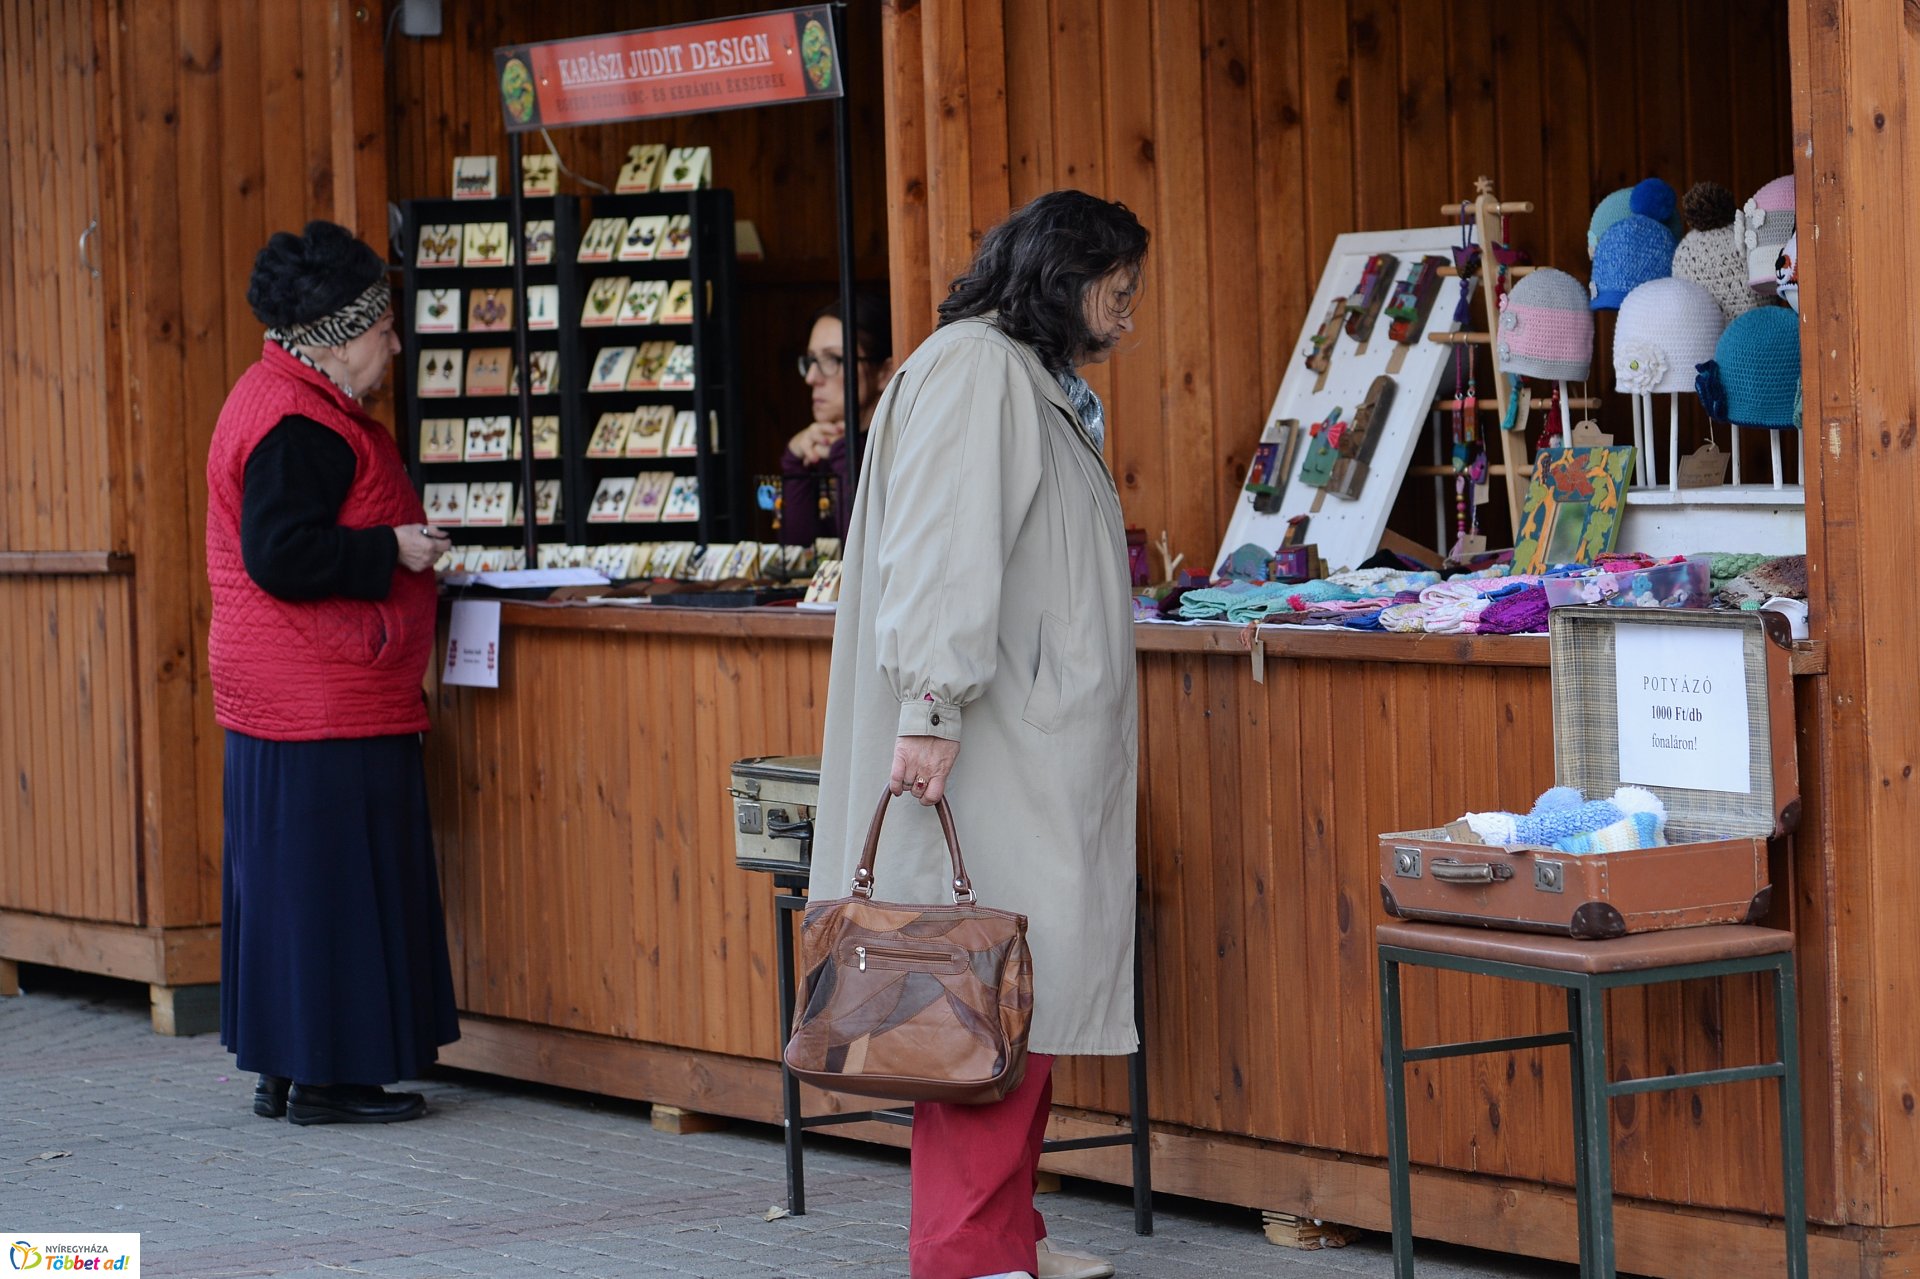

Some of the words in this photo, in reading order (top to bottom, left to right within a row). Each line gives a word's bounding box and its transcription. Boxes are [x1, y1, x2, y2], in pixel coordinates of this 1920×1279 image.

[558, 51, 625, 85] KARÁSZI
[629, 44, 684, 78] JUDIT
[689, 33, 771, 70] DESIGN
[1643, 674, 1712, 694] POTYÁZÓ
[1652, 705, 1672, 720] 1000
[1675, 706, 1703, 722] Ft/db
[1652, 733, 1697, 750] fonaláron!
